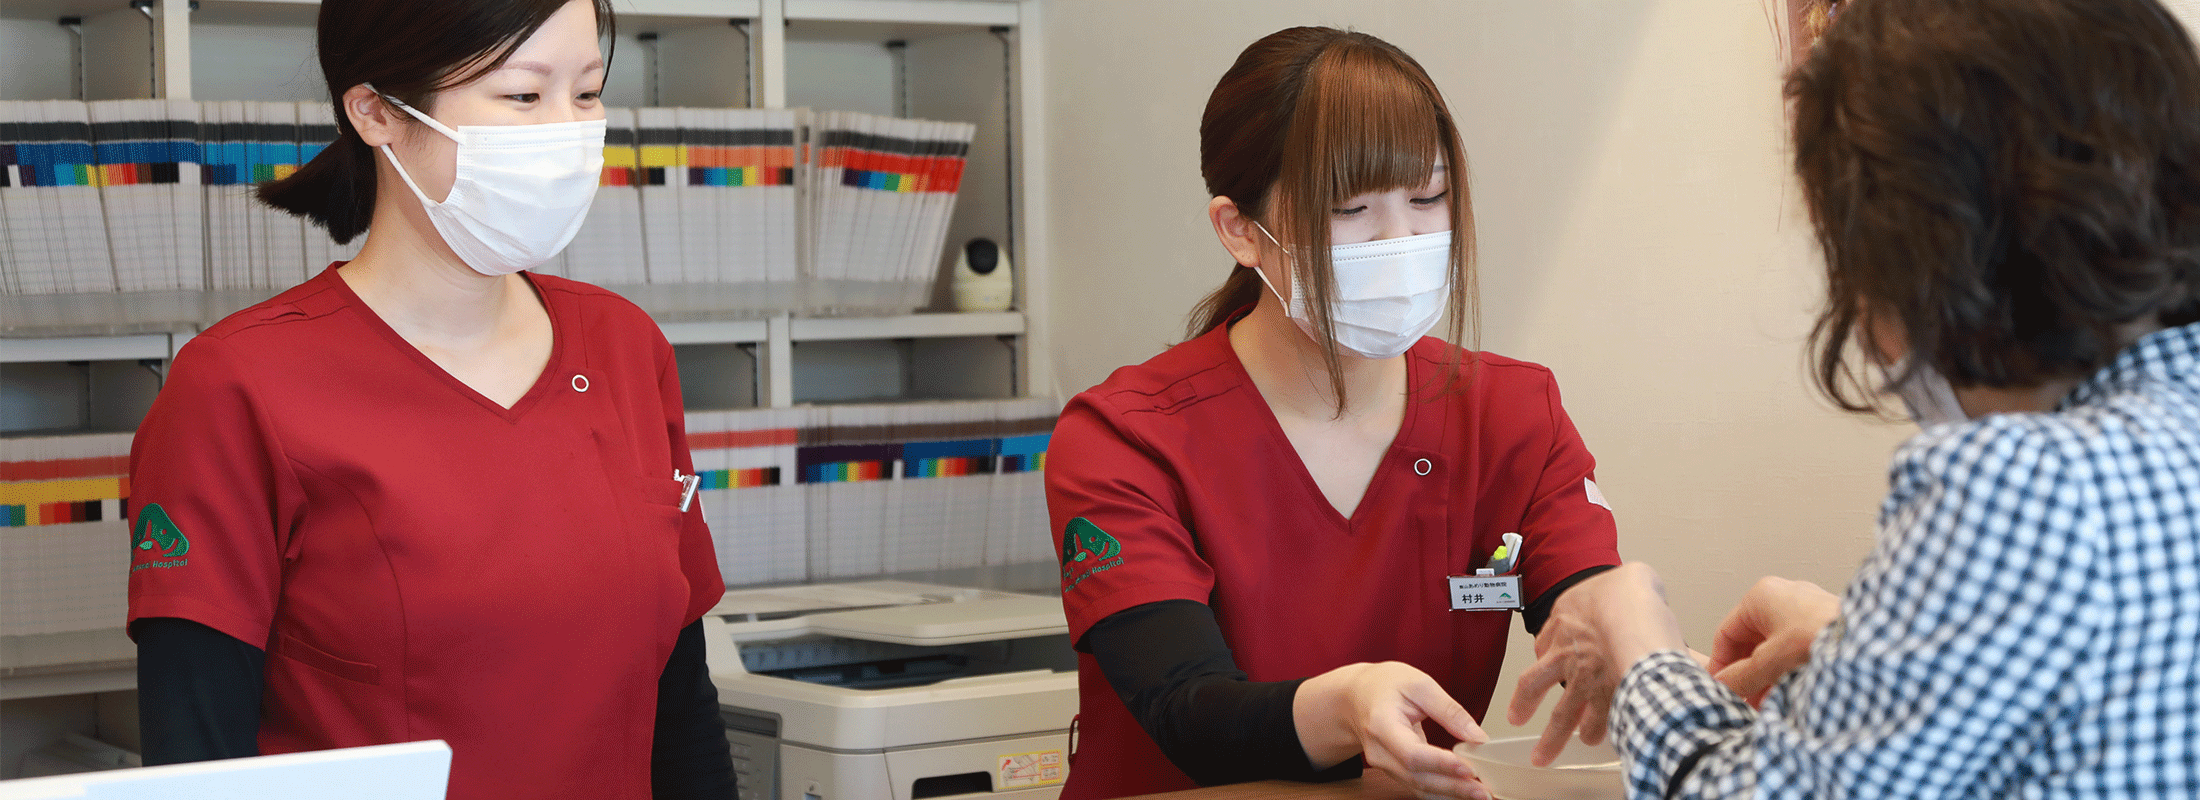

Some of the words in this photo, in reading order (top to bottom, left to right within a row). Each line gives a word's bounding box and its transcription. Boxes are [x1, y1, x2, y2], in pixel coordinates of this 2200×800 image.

[152, 558, 188, 569] Hospital
[1092, 556, 1124, 574] Hospital
[1462, 593, 1484, 604] 村井
